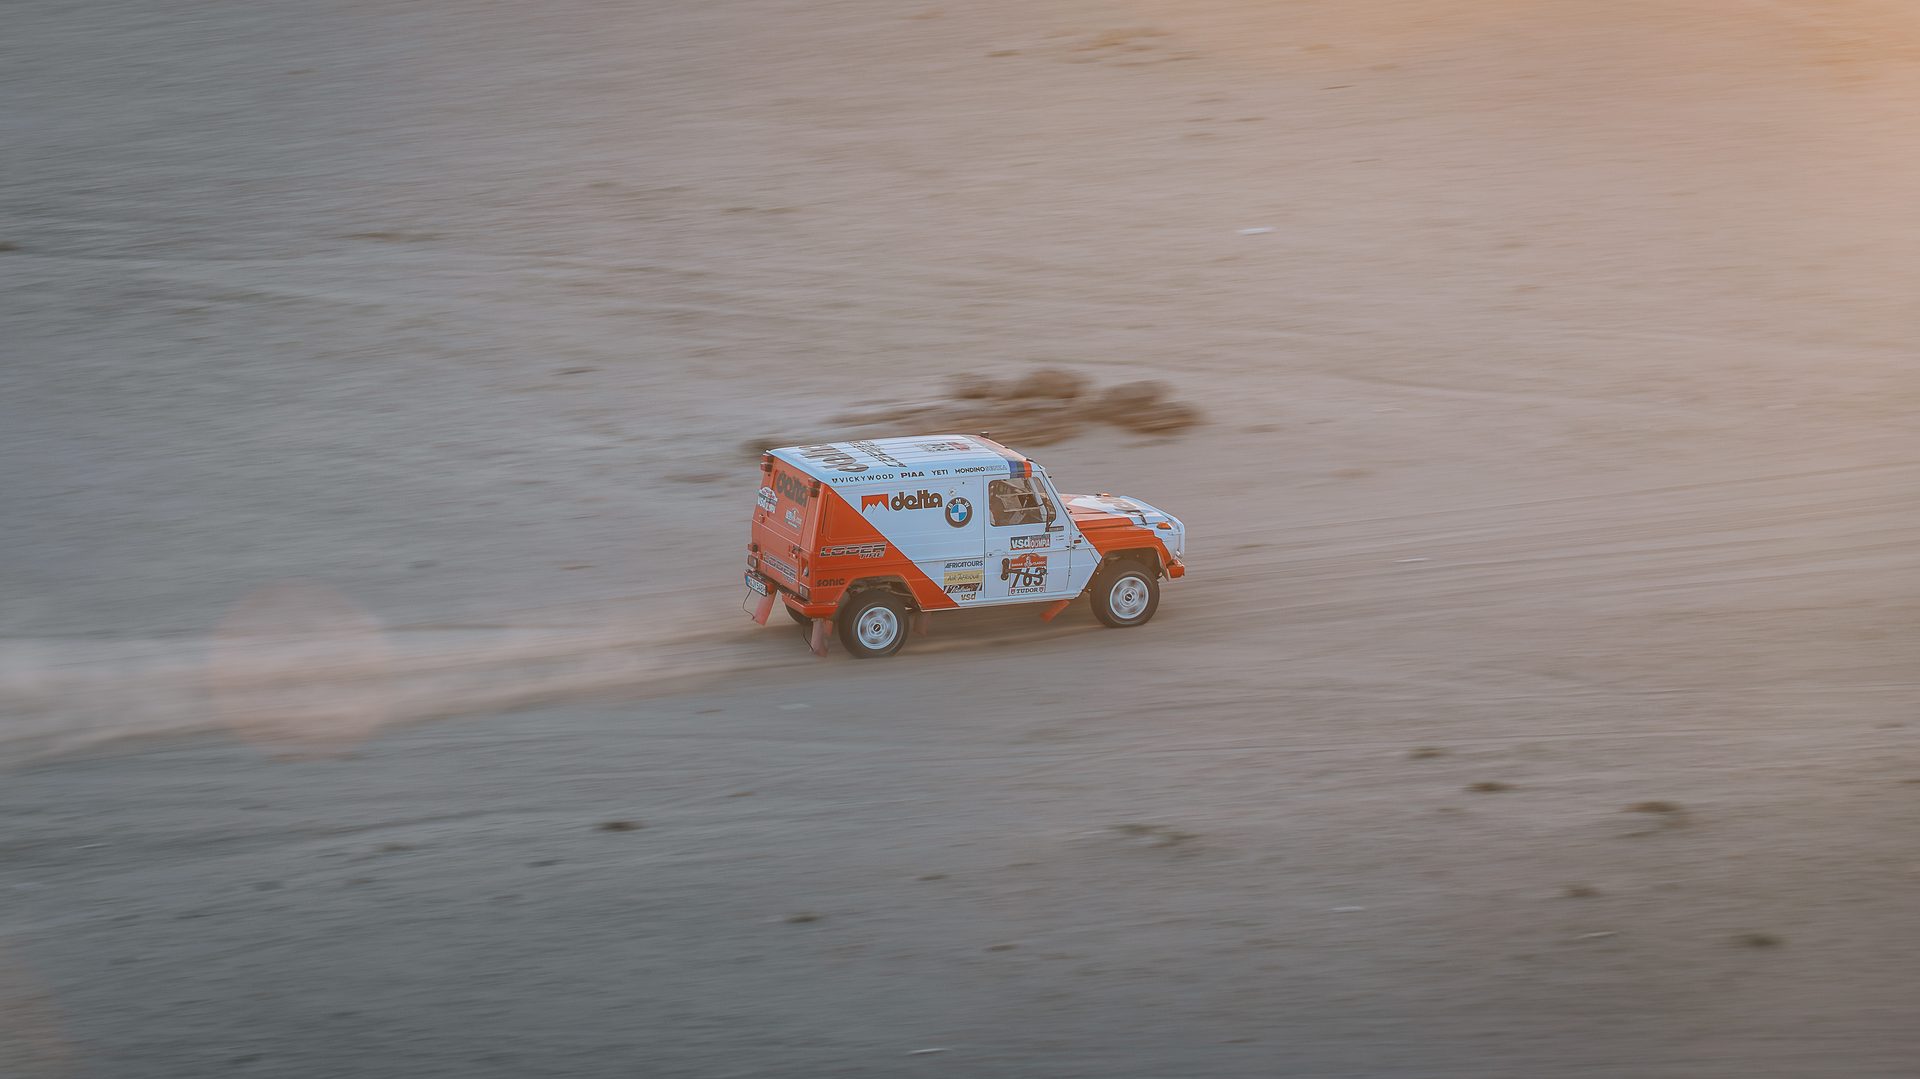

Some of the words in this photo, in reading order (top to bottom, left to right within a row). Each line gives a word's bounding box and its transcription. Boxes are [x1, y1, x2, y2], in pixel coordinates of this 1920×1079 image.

[839, 473, 894, 483] VICKYWOOD
[901, 471, 925, 479] PIAA
[890, 490, 943, 512] delta
